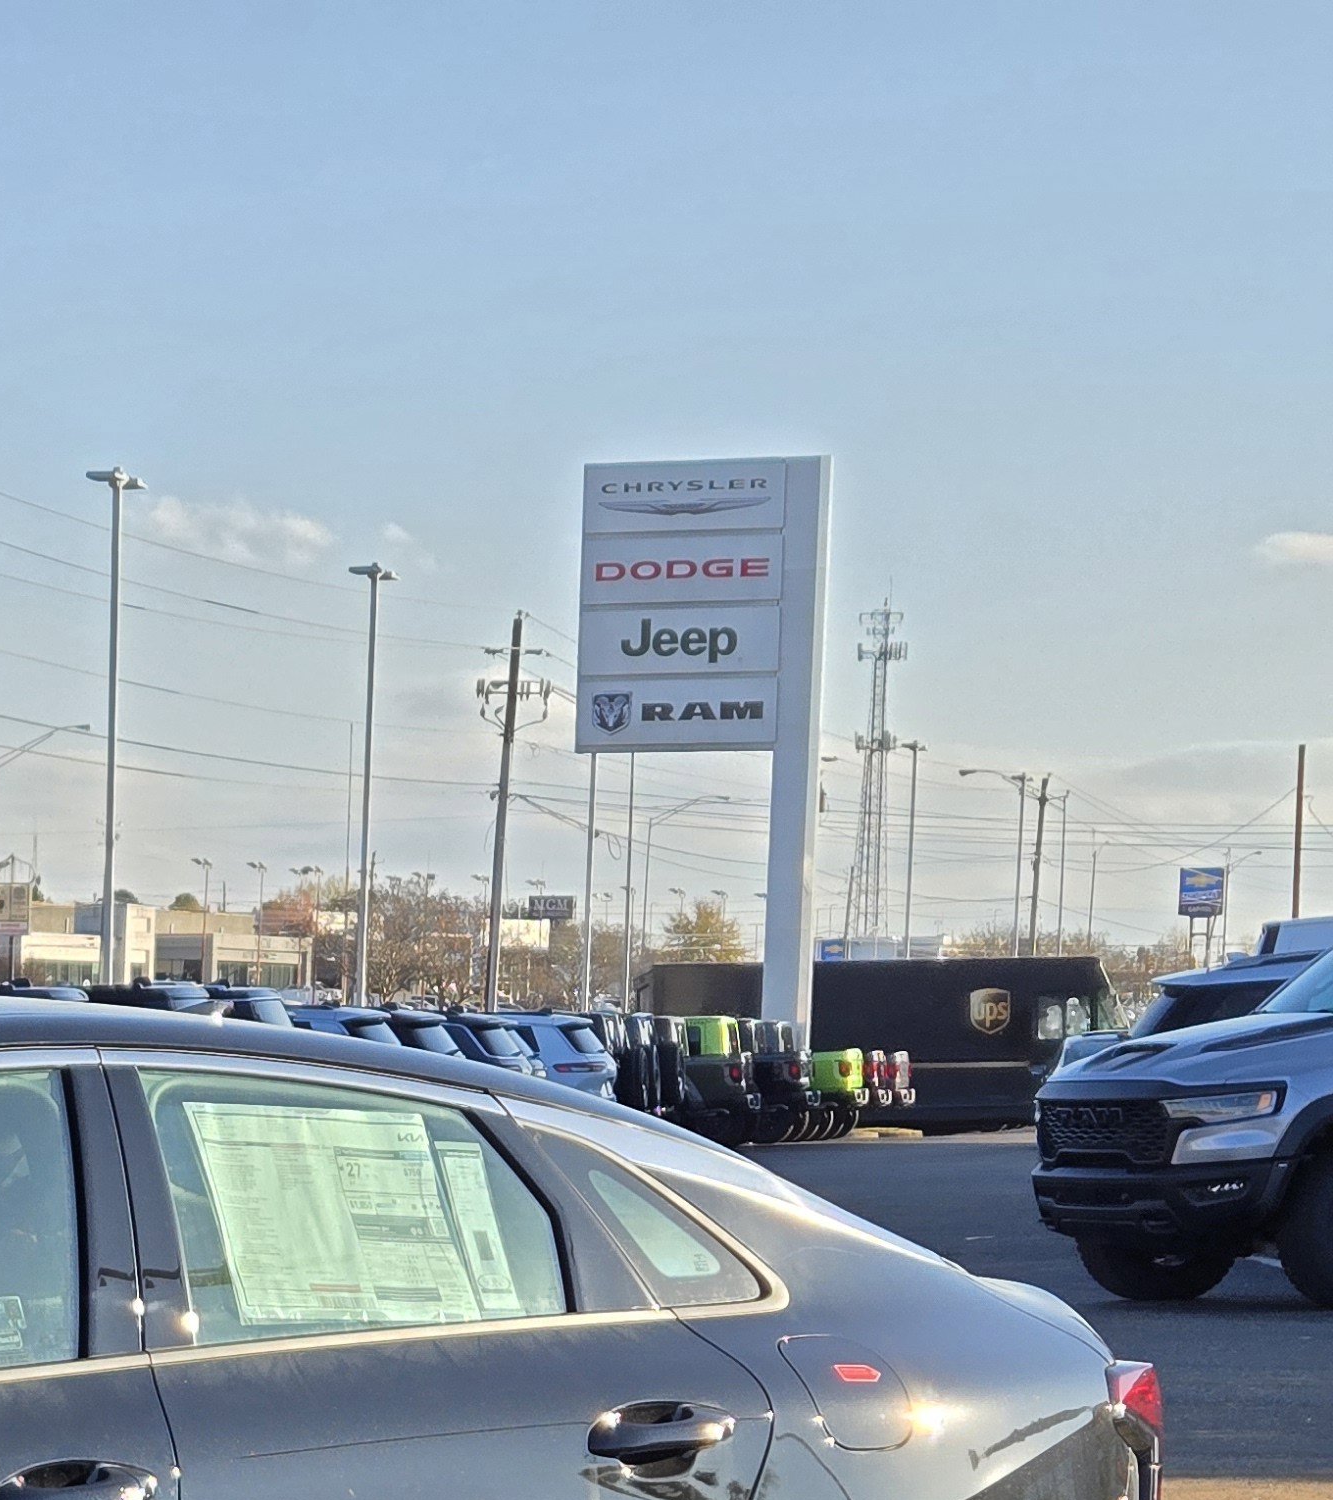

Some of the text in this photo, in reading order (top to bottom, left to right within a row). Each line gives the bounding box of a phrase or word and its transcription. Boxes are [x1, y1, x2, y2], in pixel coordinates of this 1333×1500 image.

[601, 478, 769, 494] CHRYSLER
[595, 557, 770, 582] DODGE
[620, 618, 738, 664] Jeep
[640, 700, 764, 721] RAM
[973, 1001, 1009, 1028] ups
